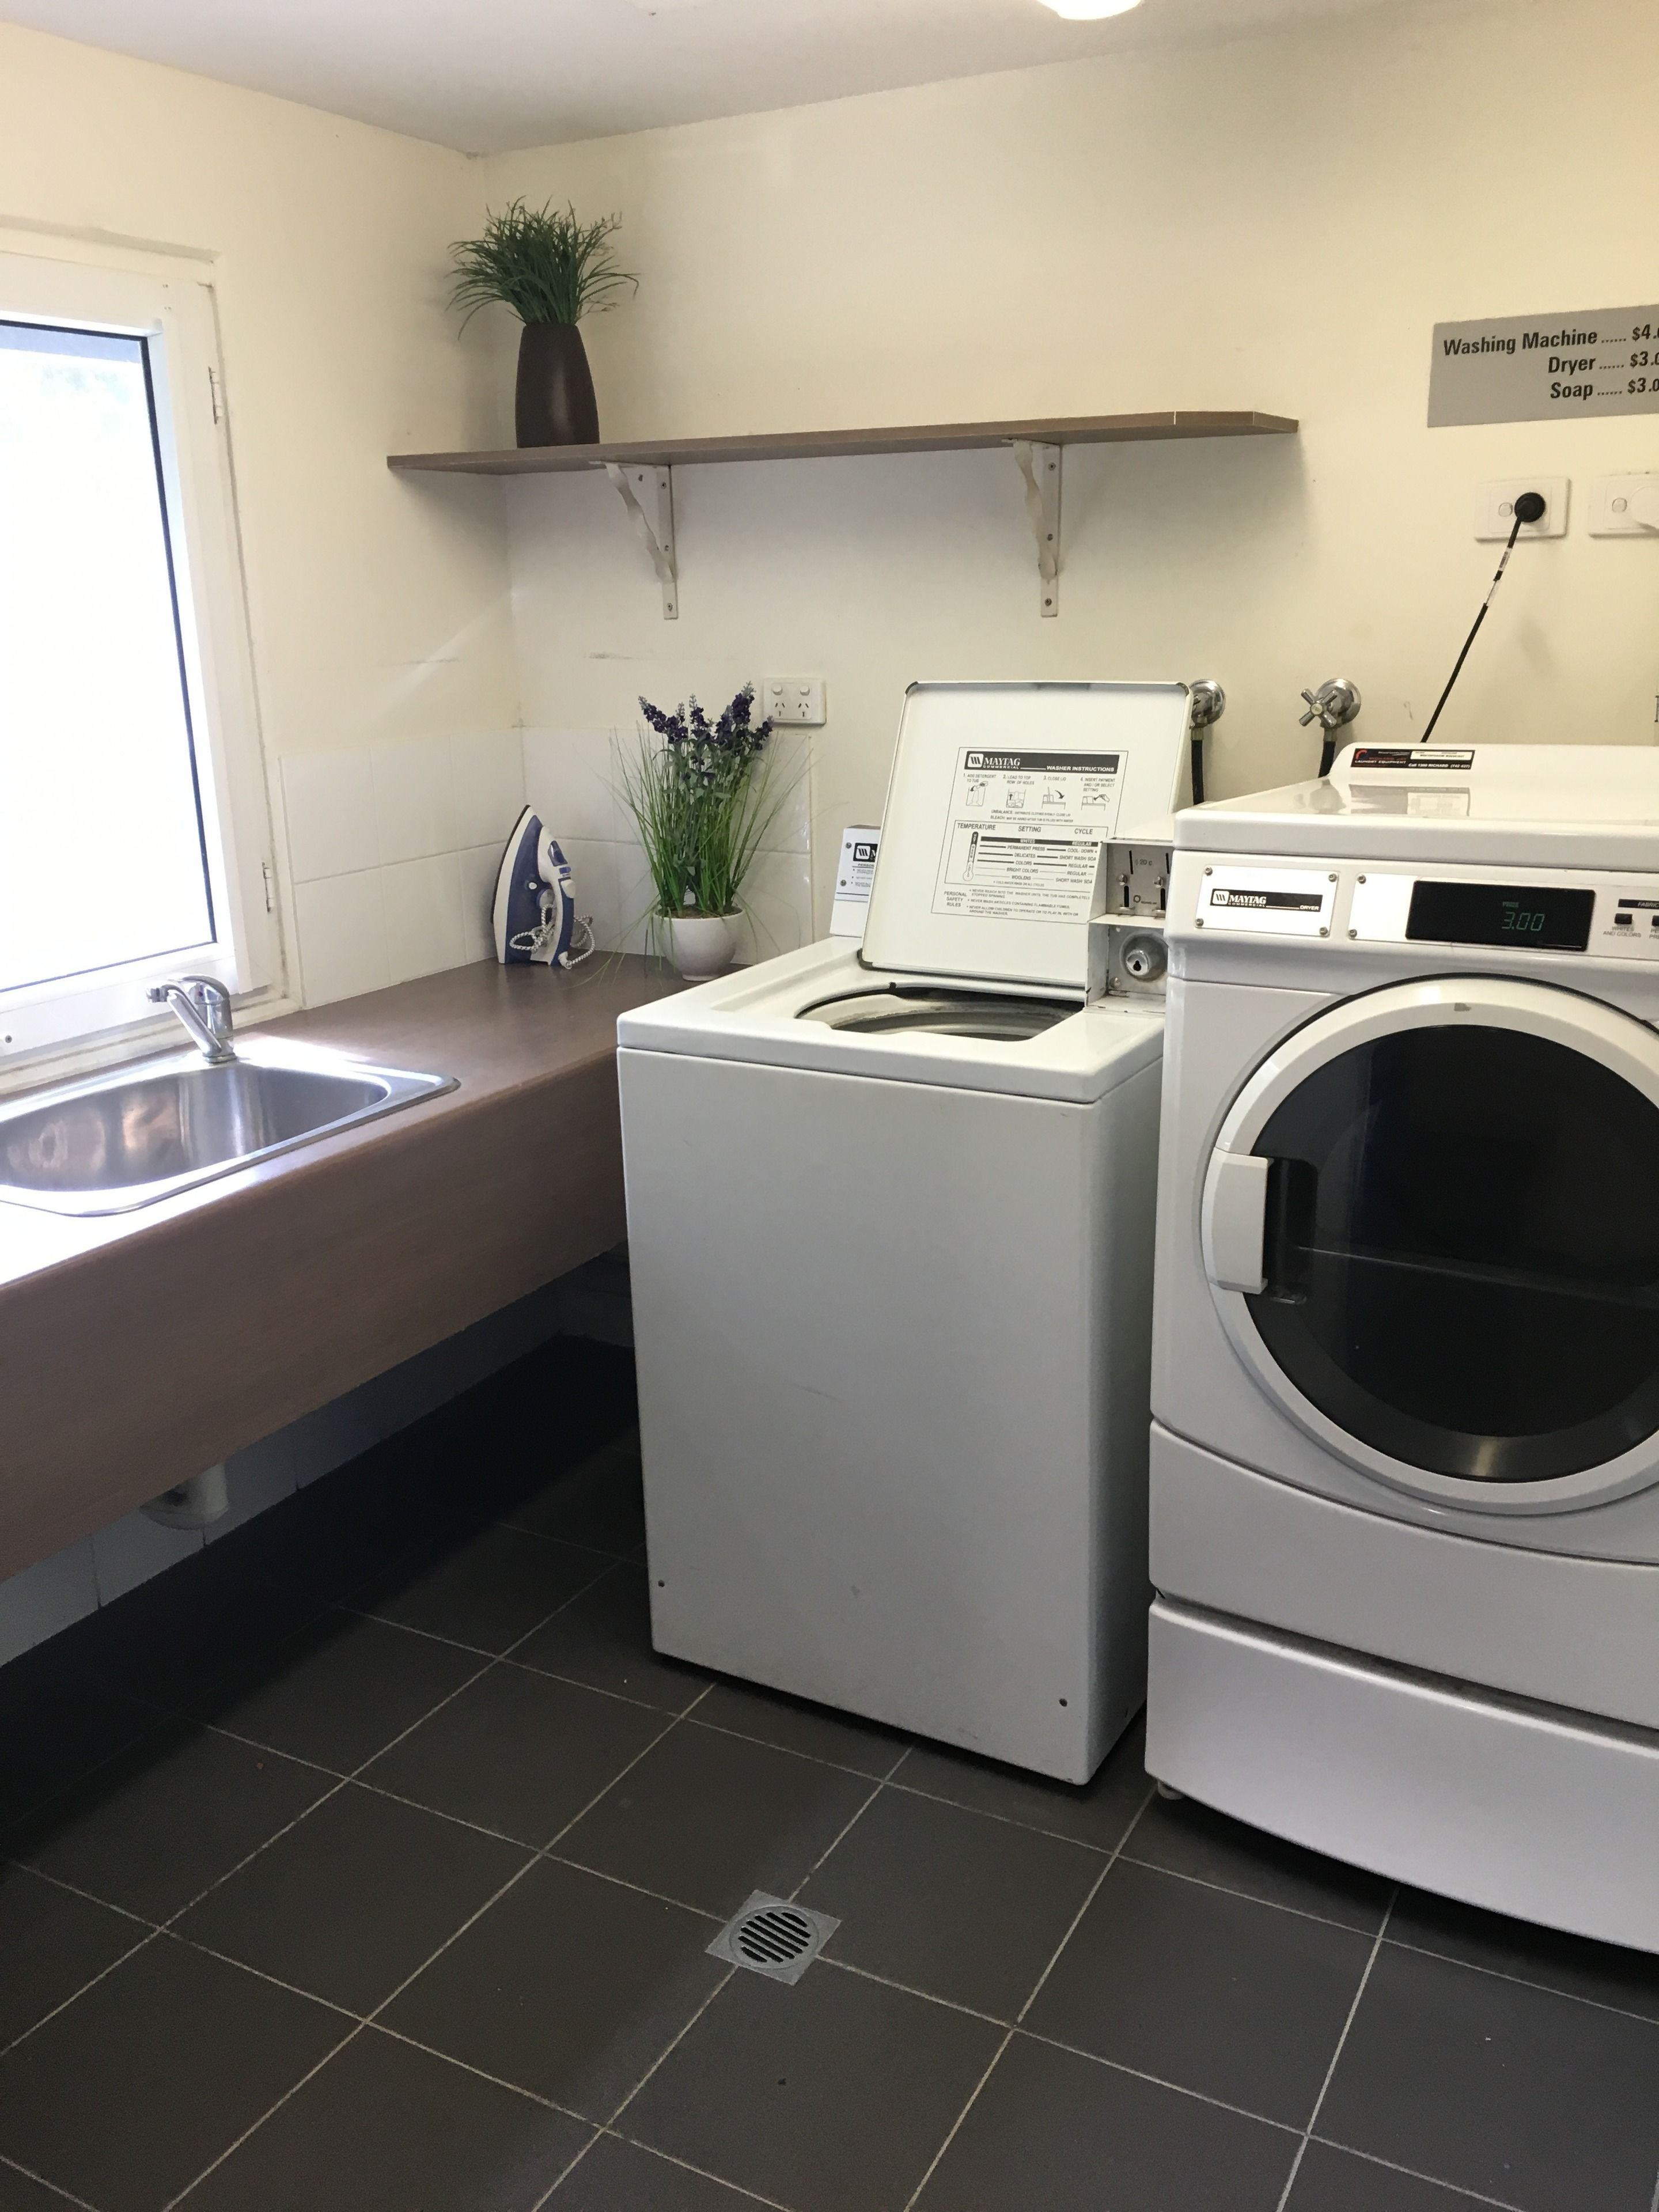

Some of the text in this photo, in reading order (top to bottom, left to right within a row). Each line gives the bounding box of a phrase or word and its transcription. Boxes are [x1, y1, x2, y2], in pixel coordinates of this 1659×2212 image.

[1444, 324, 1659, 355] Washing Machine $4.
[1548, 356, 1596, 376] Dryer
[1550, 381, 1593, 400] Soap
[984, 757, 1021, 766] MAYTAG
[1229, 895, 1267, 904] MAYTAG
[1502, 911, 1545, 931] 3.00
